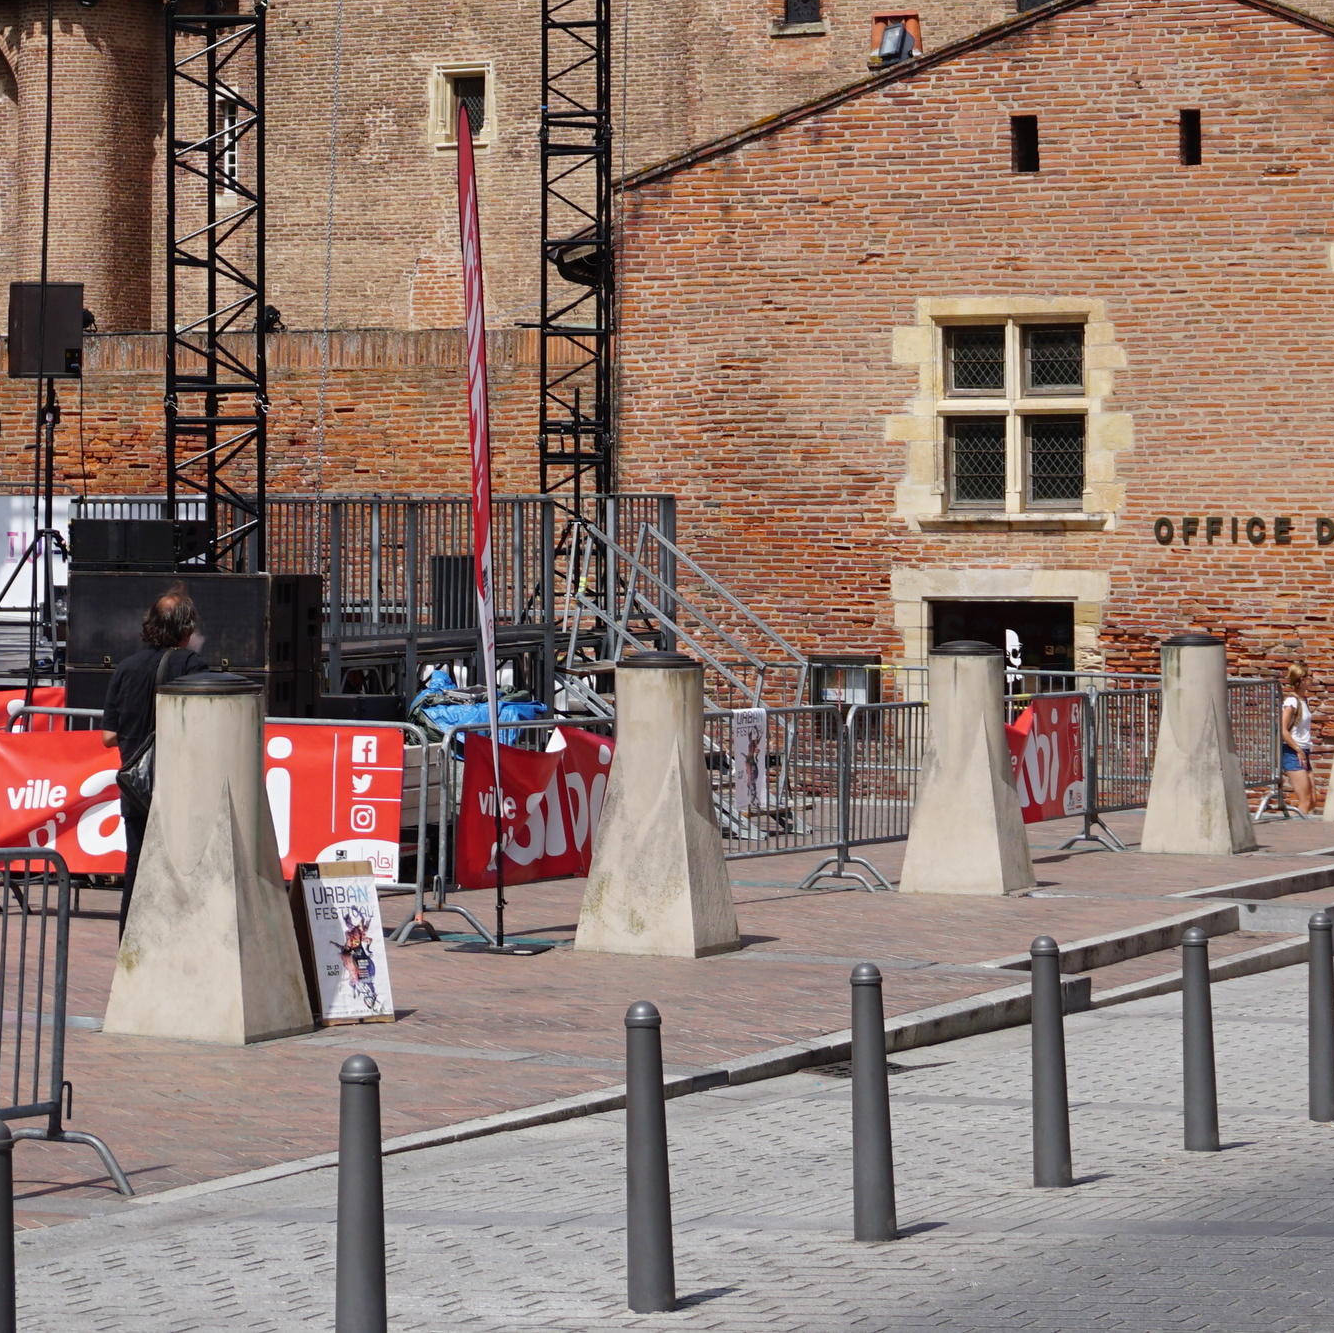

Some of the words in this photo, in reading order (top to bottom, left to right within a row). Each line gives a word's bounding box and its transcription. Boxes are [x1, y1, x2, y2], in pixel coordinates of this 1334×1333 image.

[1153, 516, 1293, 545] OFFICE
[736, 710, 763, 725] URBAN
[7, 778, 68, 810] ville
[311, 884, 369, 905] URBAN
[314, 905, 375, 921] FESTIVAL
